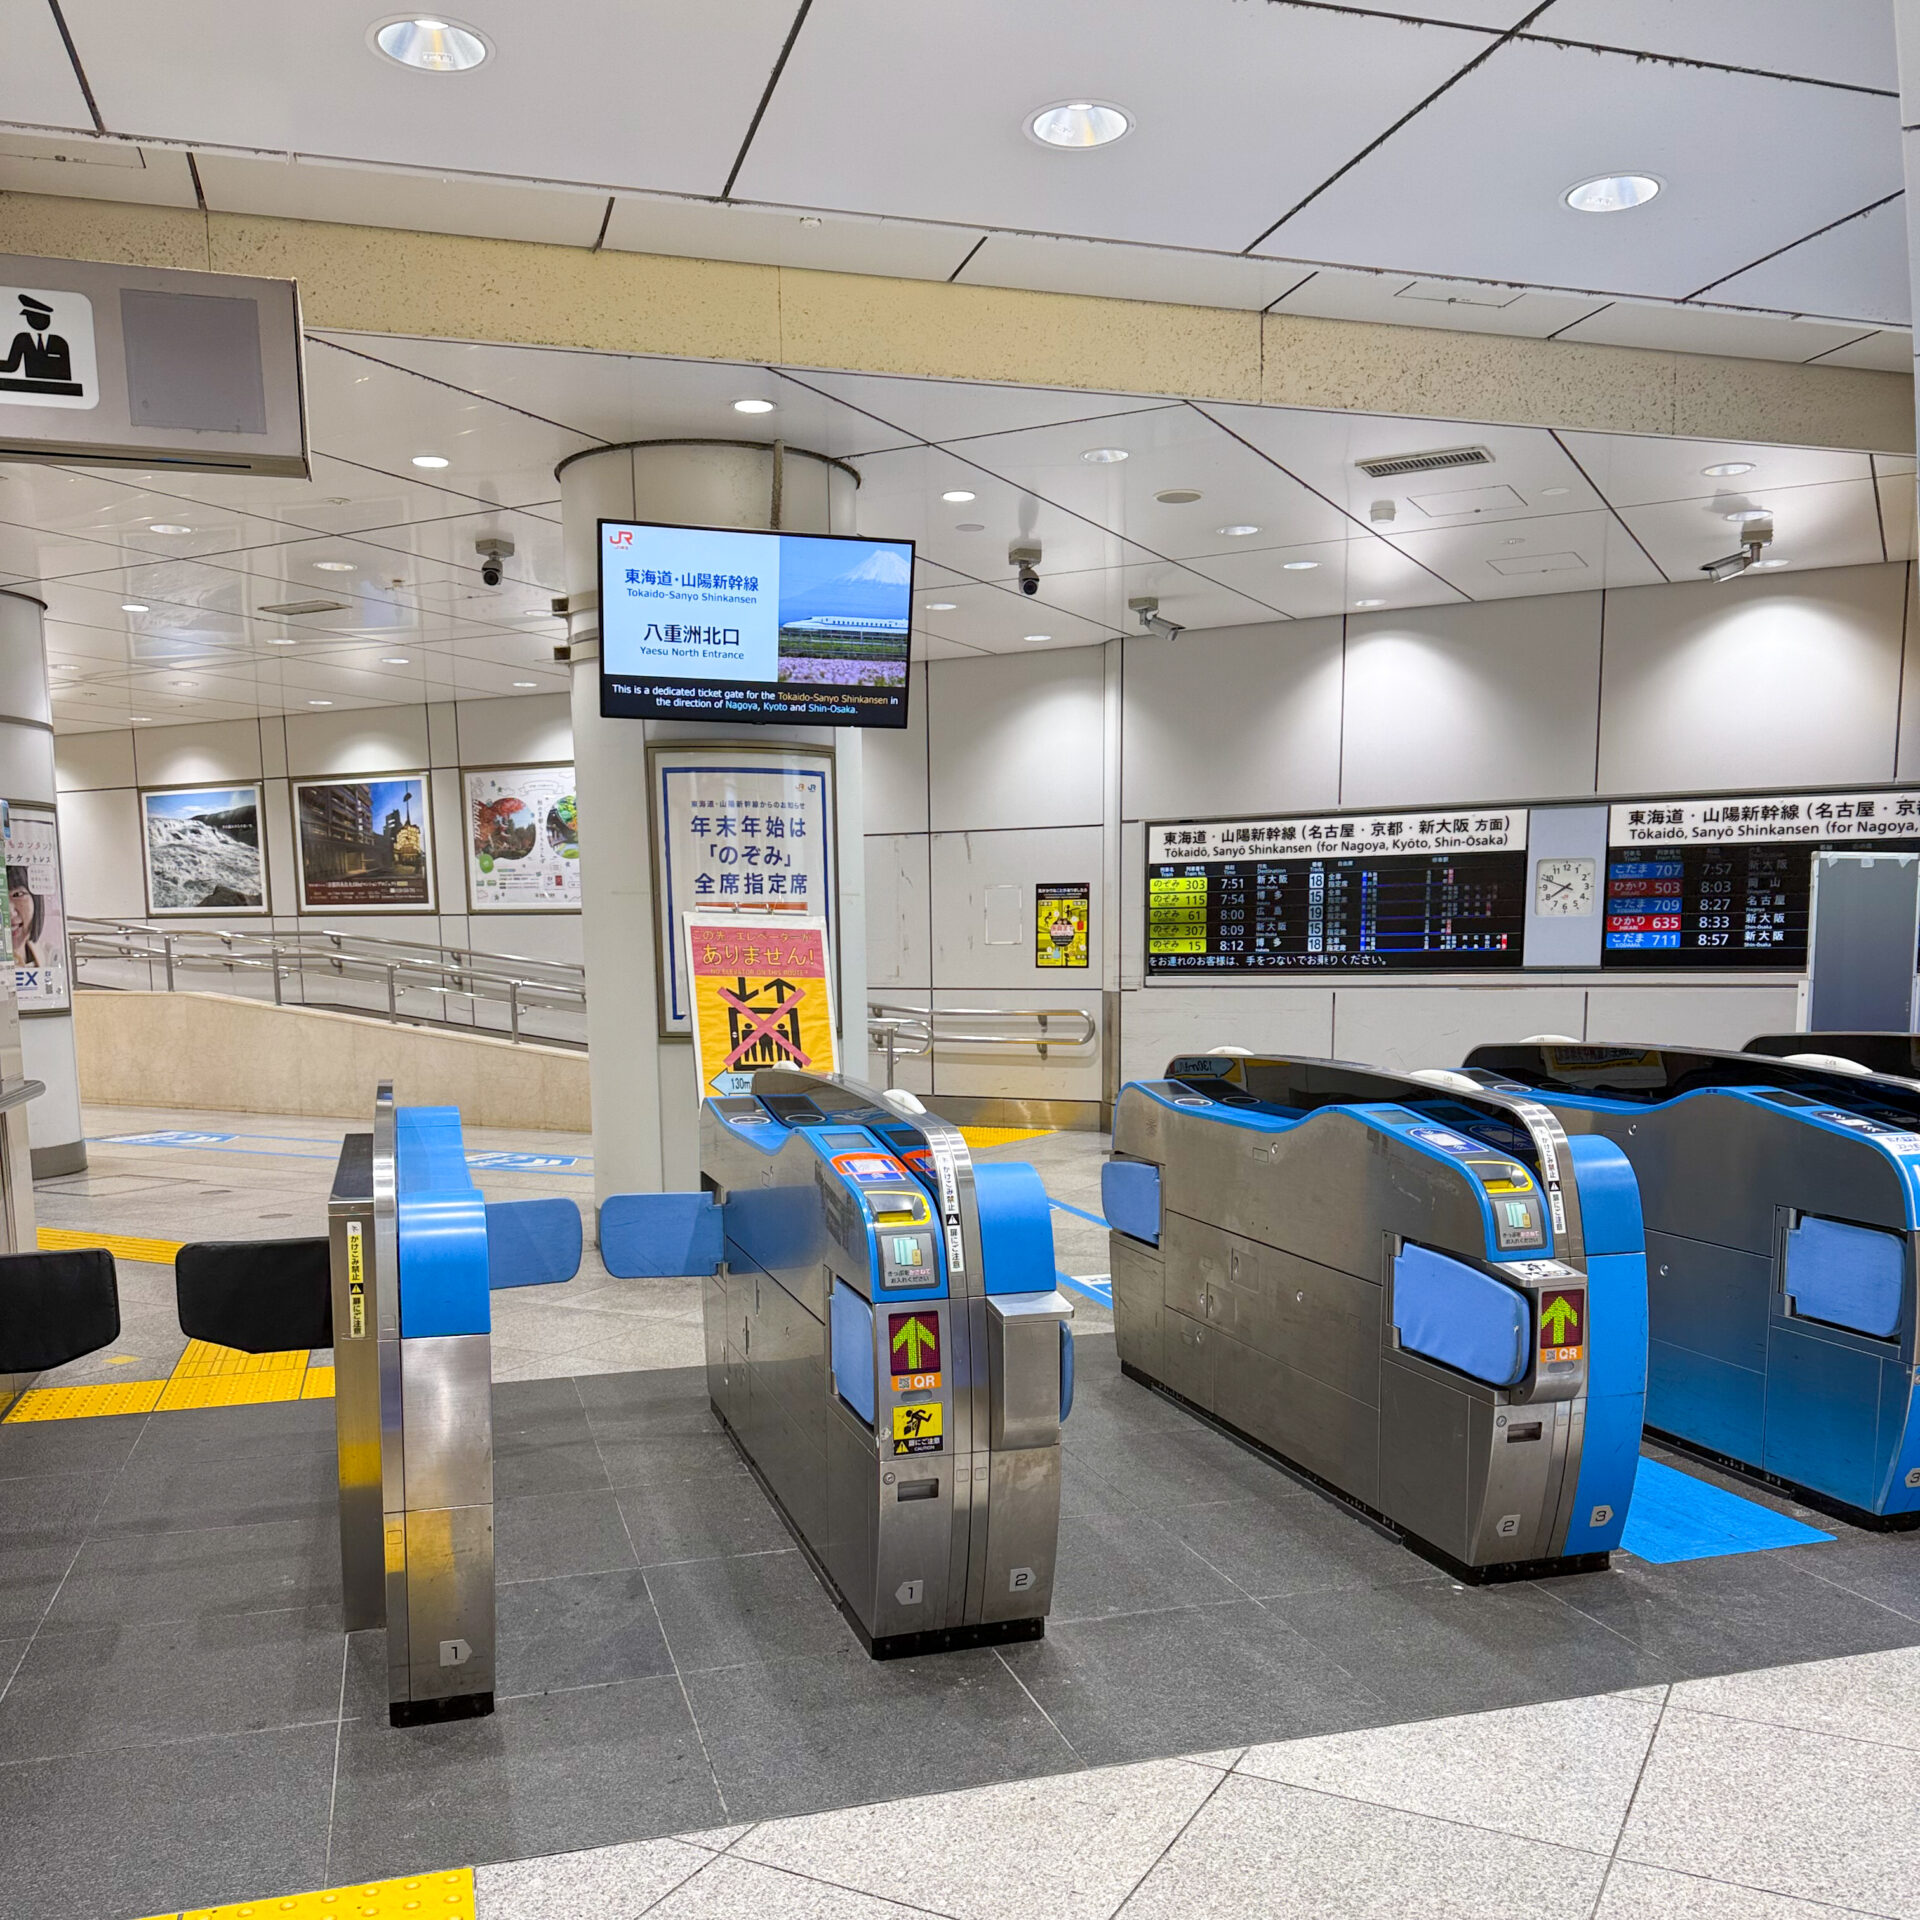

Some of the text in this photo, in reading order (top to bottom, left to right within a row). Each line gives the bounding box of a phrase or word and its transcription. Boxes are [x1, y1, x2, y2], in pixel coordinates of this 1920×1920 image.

[609, 531, 632, 545] JR
[625, 568, 759, 592] 東海道・山陽新幹線
[627, 588, 757, 604] Tokaido-Sanyo Shinkansen
[643, 623, 740, 646] 八重洲北口
[640, 646, 745, 660] Yaesu North Entrance
[612, 684, 631, 694] This
[634, 685, 641, 694] is
[652, 686, 696, 697] dedicated
[698, 688, 722, 698] ticket
[724, 690, 744, 700] gate
[746, 690, 759, 699] for
[761, 691, 775, 700] the
[778, 692, 839, 704] Tokaido-Sanyo
[841, 695, 888, 705] Shinkansen
[890, 696, 898, 705] in
[656, 698, 858, 714] the direction of Nagoya, Kyoto and Shin-Osaka.
[690, 815, 807, 839] 年末年始は
[1629, 821, 1919, 841] Tōkaidō, Sanyō Shinkansen (for Nagoya,
[710, 844, 792, 868] 「のぞみ」
[1213, 846, 1245, 859] Sanyō
[1248, 843, 1312, 855] Shinkansen
[1317, 842, 1338, 853] (for
[1341, 840, 1389, 853] Nagoya,
[1615, 864, 1647, 874] こだま
[1656, 864, 1681, 876] 707
[1702, 863, 1732, 875] 7:57
[694, 872, 808, 895] 全席指定席
[1186, 880, 1205, 889] 303
[1221, 879, 1244, 889] 7:51
[1257, 874, 1288, 884] 新大阪
[1310, 875, 1322, 886] 18
[1614, 882, 1647, 891] ひかり
[1655, 882, 1680, 894] 503
[1701, 881, 1731, 893] 8:03
[1153, 895, 1179, 903] のぞみ
[1186, 895, 1205, 905] 115
[1221, 894, 1244, 904] 7:54
[1310, 891, 1321, 902] 15
[1614, 899, 1647, 908] こだま
[1653, 900, 1679, 911] 709
[1700, 898, 1731, 910] 8:27
[1153, 910, 1179, 918] のぞみ
[1188, 911, 1200, 920] 61
[1221, 910, 1244, 920] 8:00
[1310, 907, 1322, 918] 19
[1612, 913, 1785, 929] ひかり 635 8:33 新大阪
[693, 930, 811, 943] この先 エレベーターが
[1185, 926, 1204, 936] 307
[1220, 925, 1244, 935] 8:09
[1256, 922, 1287, 931] 新大阪
[1309, 923, 1321, 934] 15
[1189, 941, 1201, 951] 15
[1220, 940, 1244, 951] 8:12
[1309, 939, 1321, 950] 18
[1612, 930, 1784, 946] こだま 711 8:57 新大阪
[703, 944, 814, 966] ありません!
[15, 971, 38, 986] EX
[1542, 1138, 1557, 1179] かけこみ禁止
[943, 1166, 956, 1211] かけこみ禁止
[351, 1236, 360, 1281] かけこみ禁止
[1559, 1347, 1577, 1359] QR
[913, 1375, 935, 1388] QR
[1595, 1510, 1607, 1522] 3
[1502, 1520, 1514, 1532] 2
[1015, 1573, 1028, 1587] 2
[908, 1586, 914, 1599] 1
[451, 1646, 458, 1660] 1
